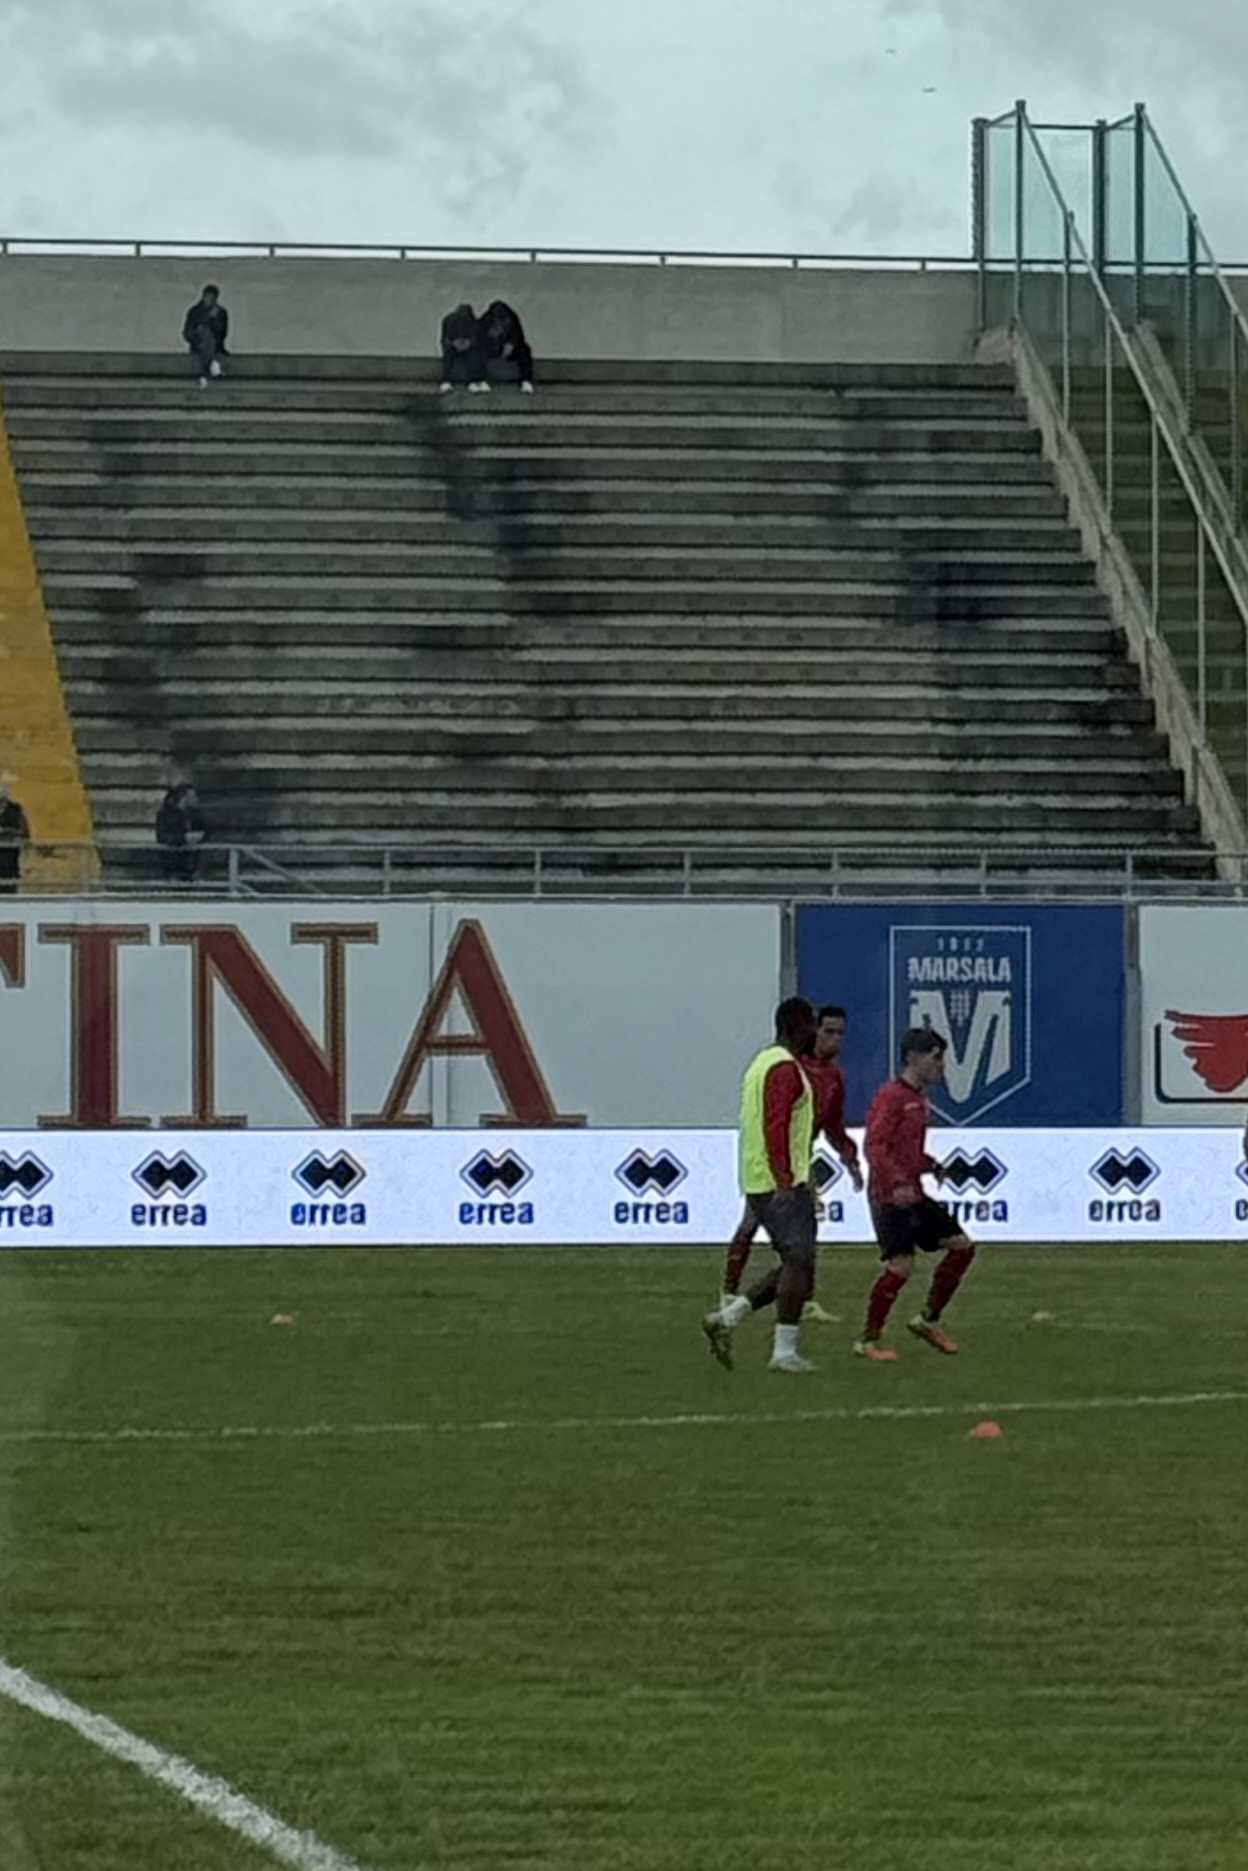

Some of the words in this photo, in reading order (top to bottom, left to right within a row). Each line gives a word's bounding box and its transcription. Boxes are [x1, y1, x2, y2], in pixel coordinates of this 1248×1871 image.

[907, 956, 1012, 982] MARSALA
[0, 918, 588, 1128] INA
[0, 1203, 54, 1227] rrea
[130, 1203, 207, 1227] errea
[290, 1202, 366, 1226] errea
[459, 1201, 534, 1225] errea
[614, 1201, 689, 1225] errea
[1089, 1199, 1161, 1222] errea
